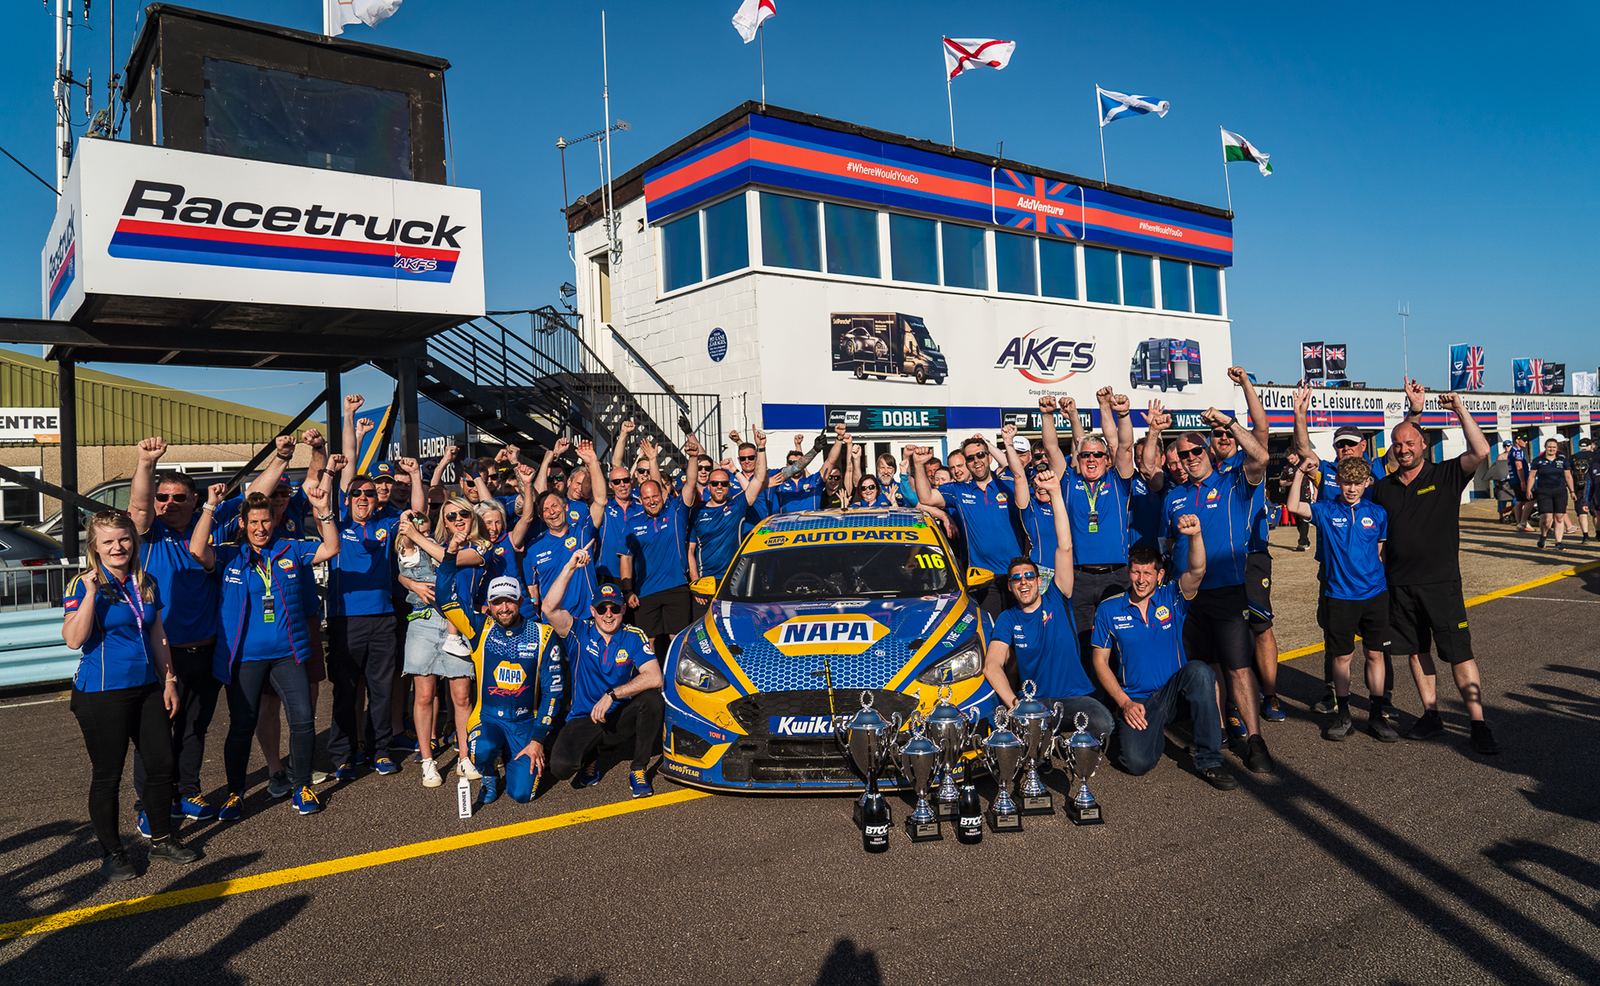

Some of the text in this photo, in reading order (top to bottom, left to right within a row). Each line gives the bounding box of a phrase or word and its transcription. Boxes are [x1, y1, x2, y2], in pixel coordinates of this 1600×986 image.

[847, 161, 919, 184] #WhereWouldYouGo
[122, 179, 467, 248] Racetruck
[1017, 197, 1064, 216] AddVenture
[1139, 222, 1183, 237] #WhereWouldYouGo
[393, 257, 437, 271] AKFS
[994, 336, 1096, 375] AKFS
[1257, 389, 1384, 410] ddVene-Leisure.com
[1511, 397, 1579, 411] AddVenture-Leisure.com
[882, 411, 929, 426] DOBLE
[1031, 413, 1091, 428] TAOR-STH
[1176, 414, 1209, 427] WATS
[419, 436, 446, 459] LEADER
[766, 530, 919, 545] NAPA AUTO PARTS
[915, 553, 945, 569] 116
[1156, 608, 1169, 617] NAPA
[783, 622, 869, 643] NAPA
[1162, 623, 1172, 631] TEAM
[499, 667, 522, 683] NAPA
[777, 716, 854, 735] KwikF
[709, 731, 721, 739] TOW
[668, 763, 700, 778] GOODYEAR
[960, 815, 982, 826] BTCC
[865, 824, 889, 835] BTCC
